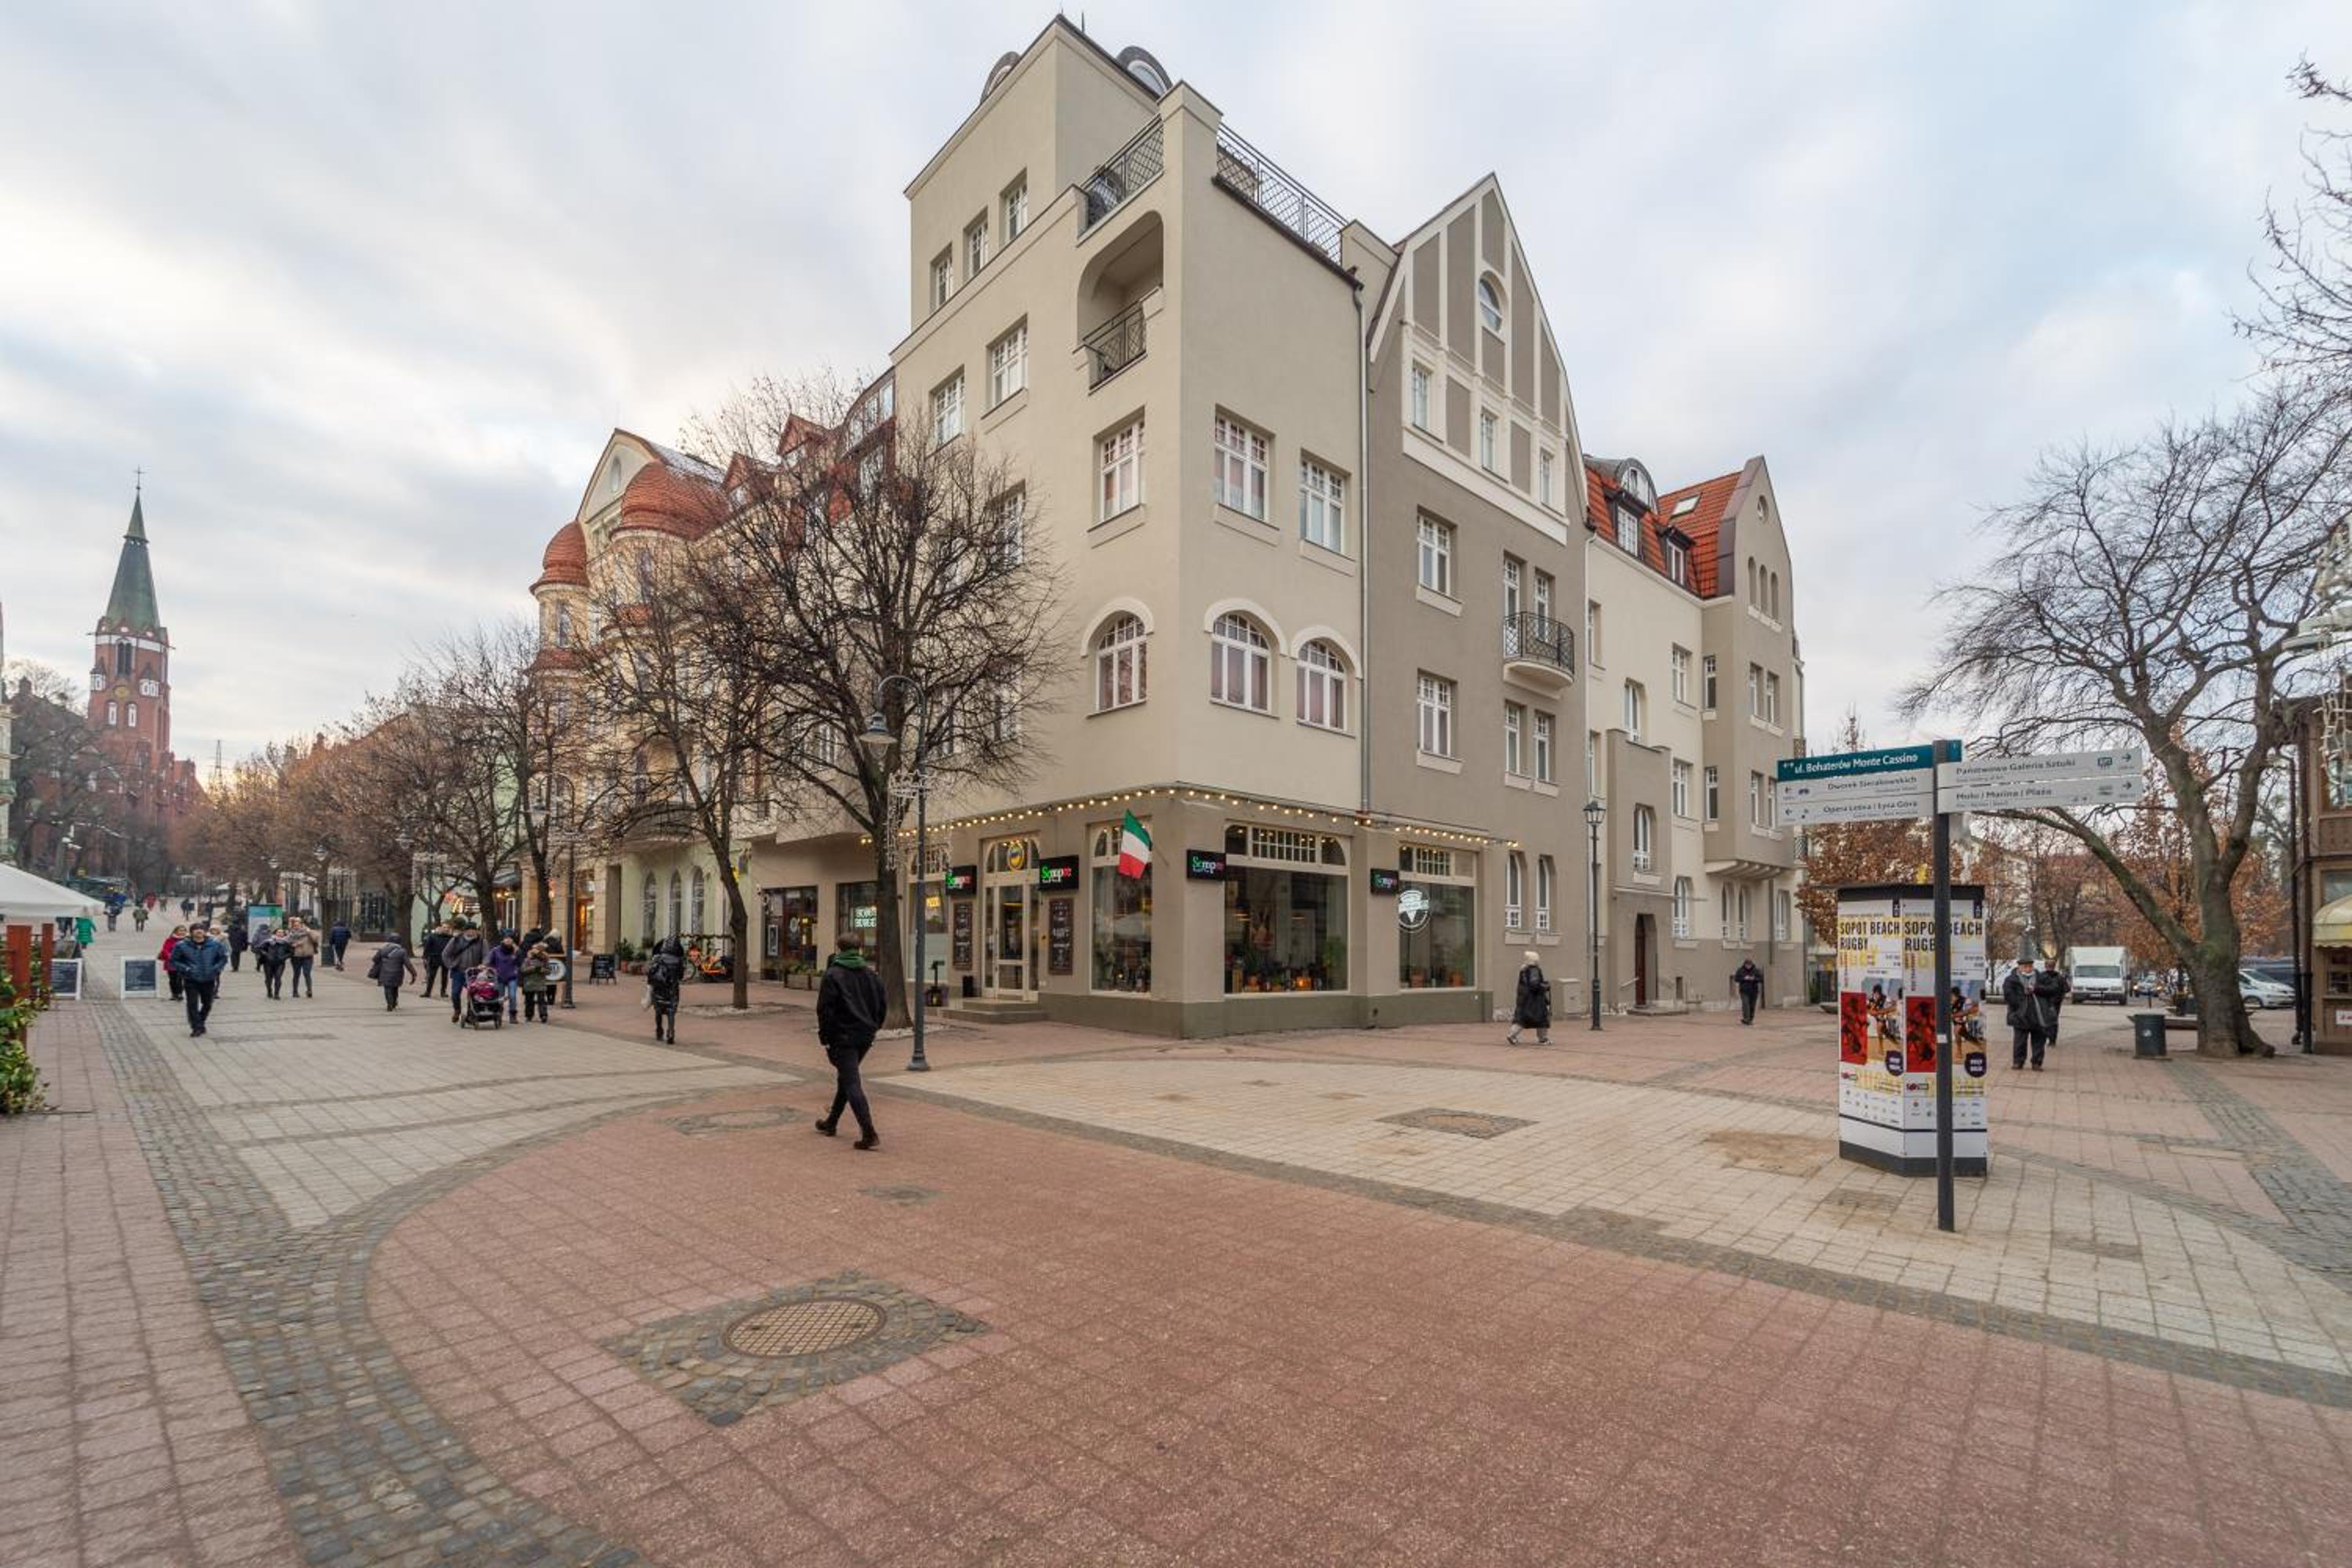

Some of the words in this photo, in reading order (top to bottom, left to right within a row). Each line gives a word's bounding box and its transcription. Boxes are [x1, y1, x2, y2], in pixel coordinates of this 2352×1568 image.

[1795, 764, 1806, 774] ul.
[1806, 760, 1852, 773] Bohaterów
[1853, 757, 1881, 768] Monte
[1882, 752, 1918, 764] Cassino
[2009, 760, 2045, 771] Galeria
[2045, 758, 2076, 768] Sztuki
[1828, 781, 1857, 791] Dworek
[1986, 789, 2019, 800] Marina
[1823, 805, 1848, 815] Opera
[1041, 865, 1072, 882] Sempre
[1839, 921, 1867, 935] SOPOT
[1870, 920, 1900, 935] BEACH
[1904, 921, 1934, 935] SOPO
[1951, 921, 1983, 935] EACH
[1839, 937, 1868, 951] RUGBY
